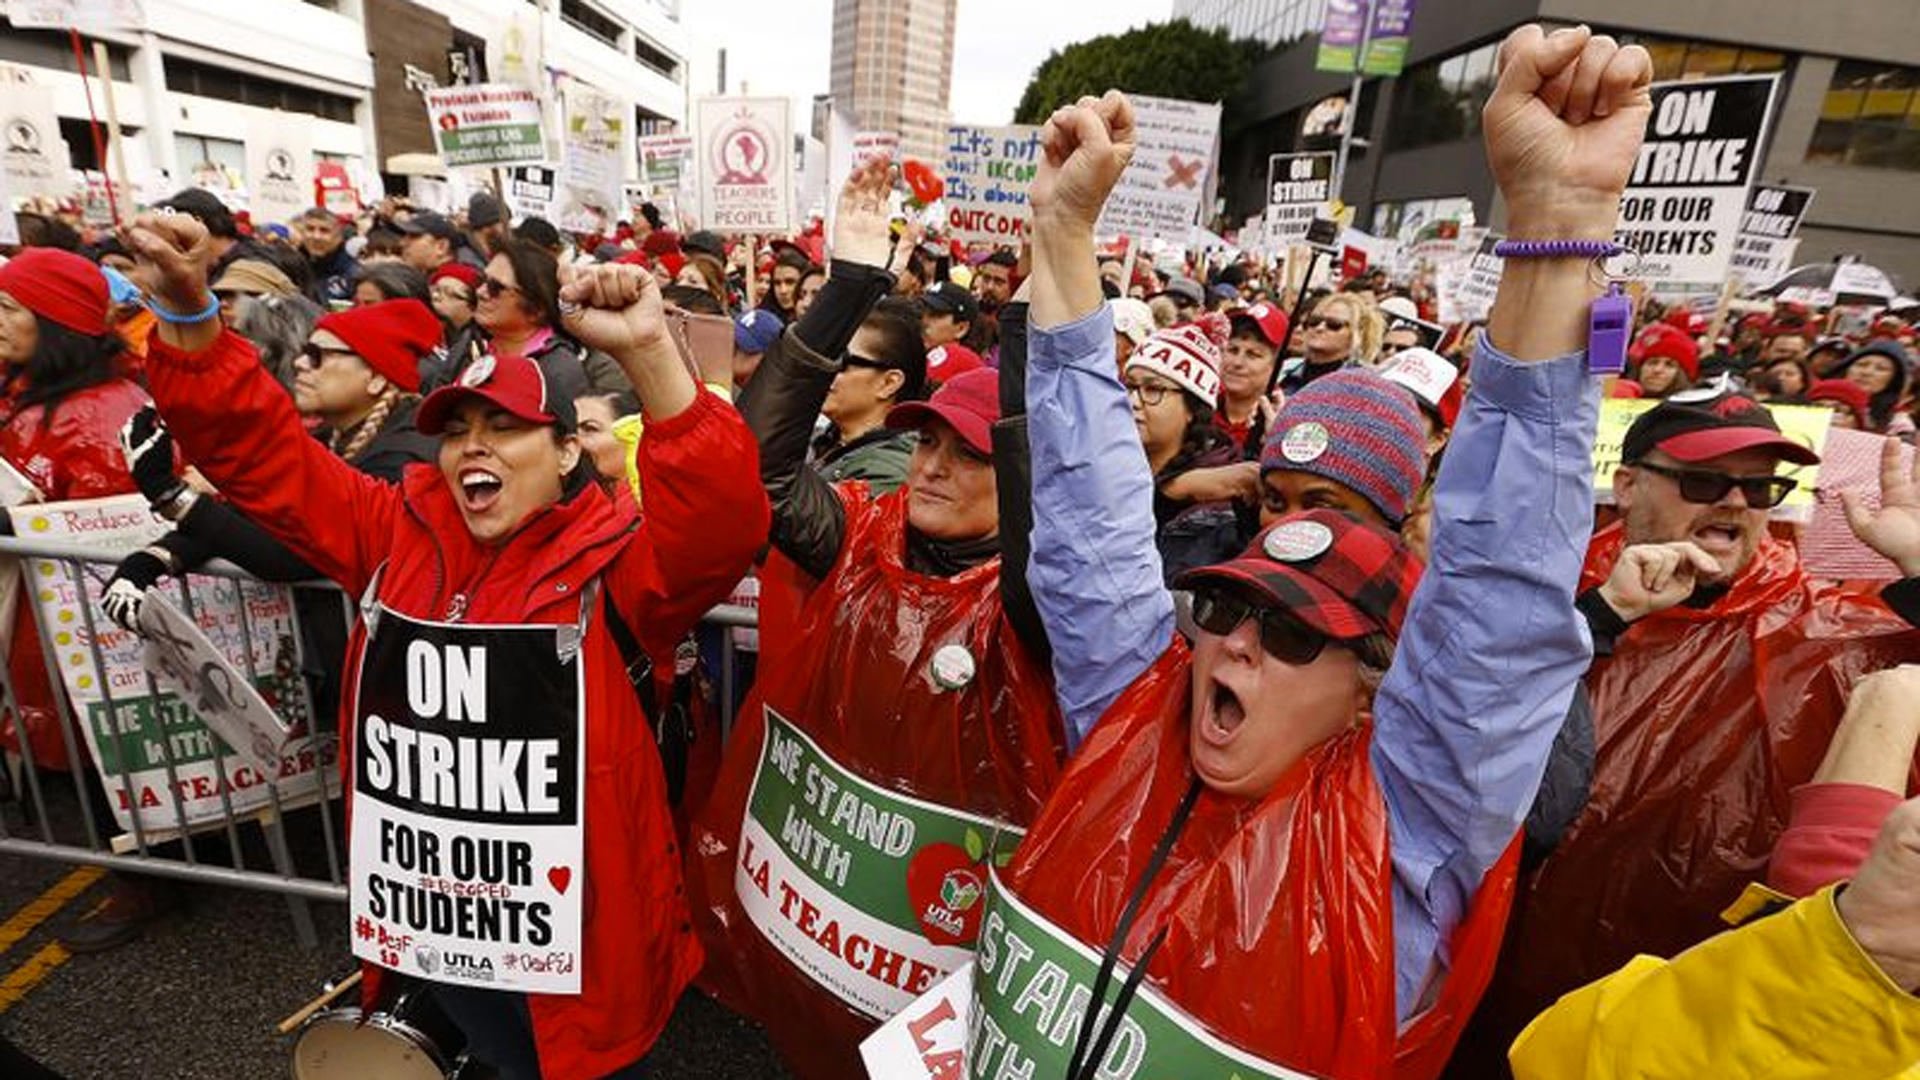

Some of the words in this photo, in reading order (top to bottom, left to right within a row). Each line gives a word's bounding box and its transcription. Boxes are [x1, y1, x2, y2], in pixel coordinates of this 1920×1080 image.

[1655, 90, 1717, 137] ON
[1290, 158, 1314, 180] ON
[1273, 179, 1328, 203] STRIKE
[1661, 196, 1714, 222] OUR
[1753, 188, 1787, 212] ON
[714, 210, 779, 226] PEOPLE
[62, 507, 143, 533] Reduce
[407, 639, 487, 722] ON
[364, 714, 561, 815] STRIKE
[770, 726, 803, 785] WE
[804, 762, 916, 858] STAND
[381, 818, 441, 877] FOR
[451, 836, 533, 887] OUR
[781, 804, 852, 888] WITH
[741, 836, 770, 898] LA
[368, 873, 553, 947] STUDENTS
[927, 903, 963, 931] UTLA
[444, 952, 493, 970] UTLA
